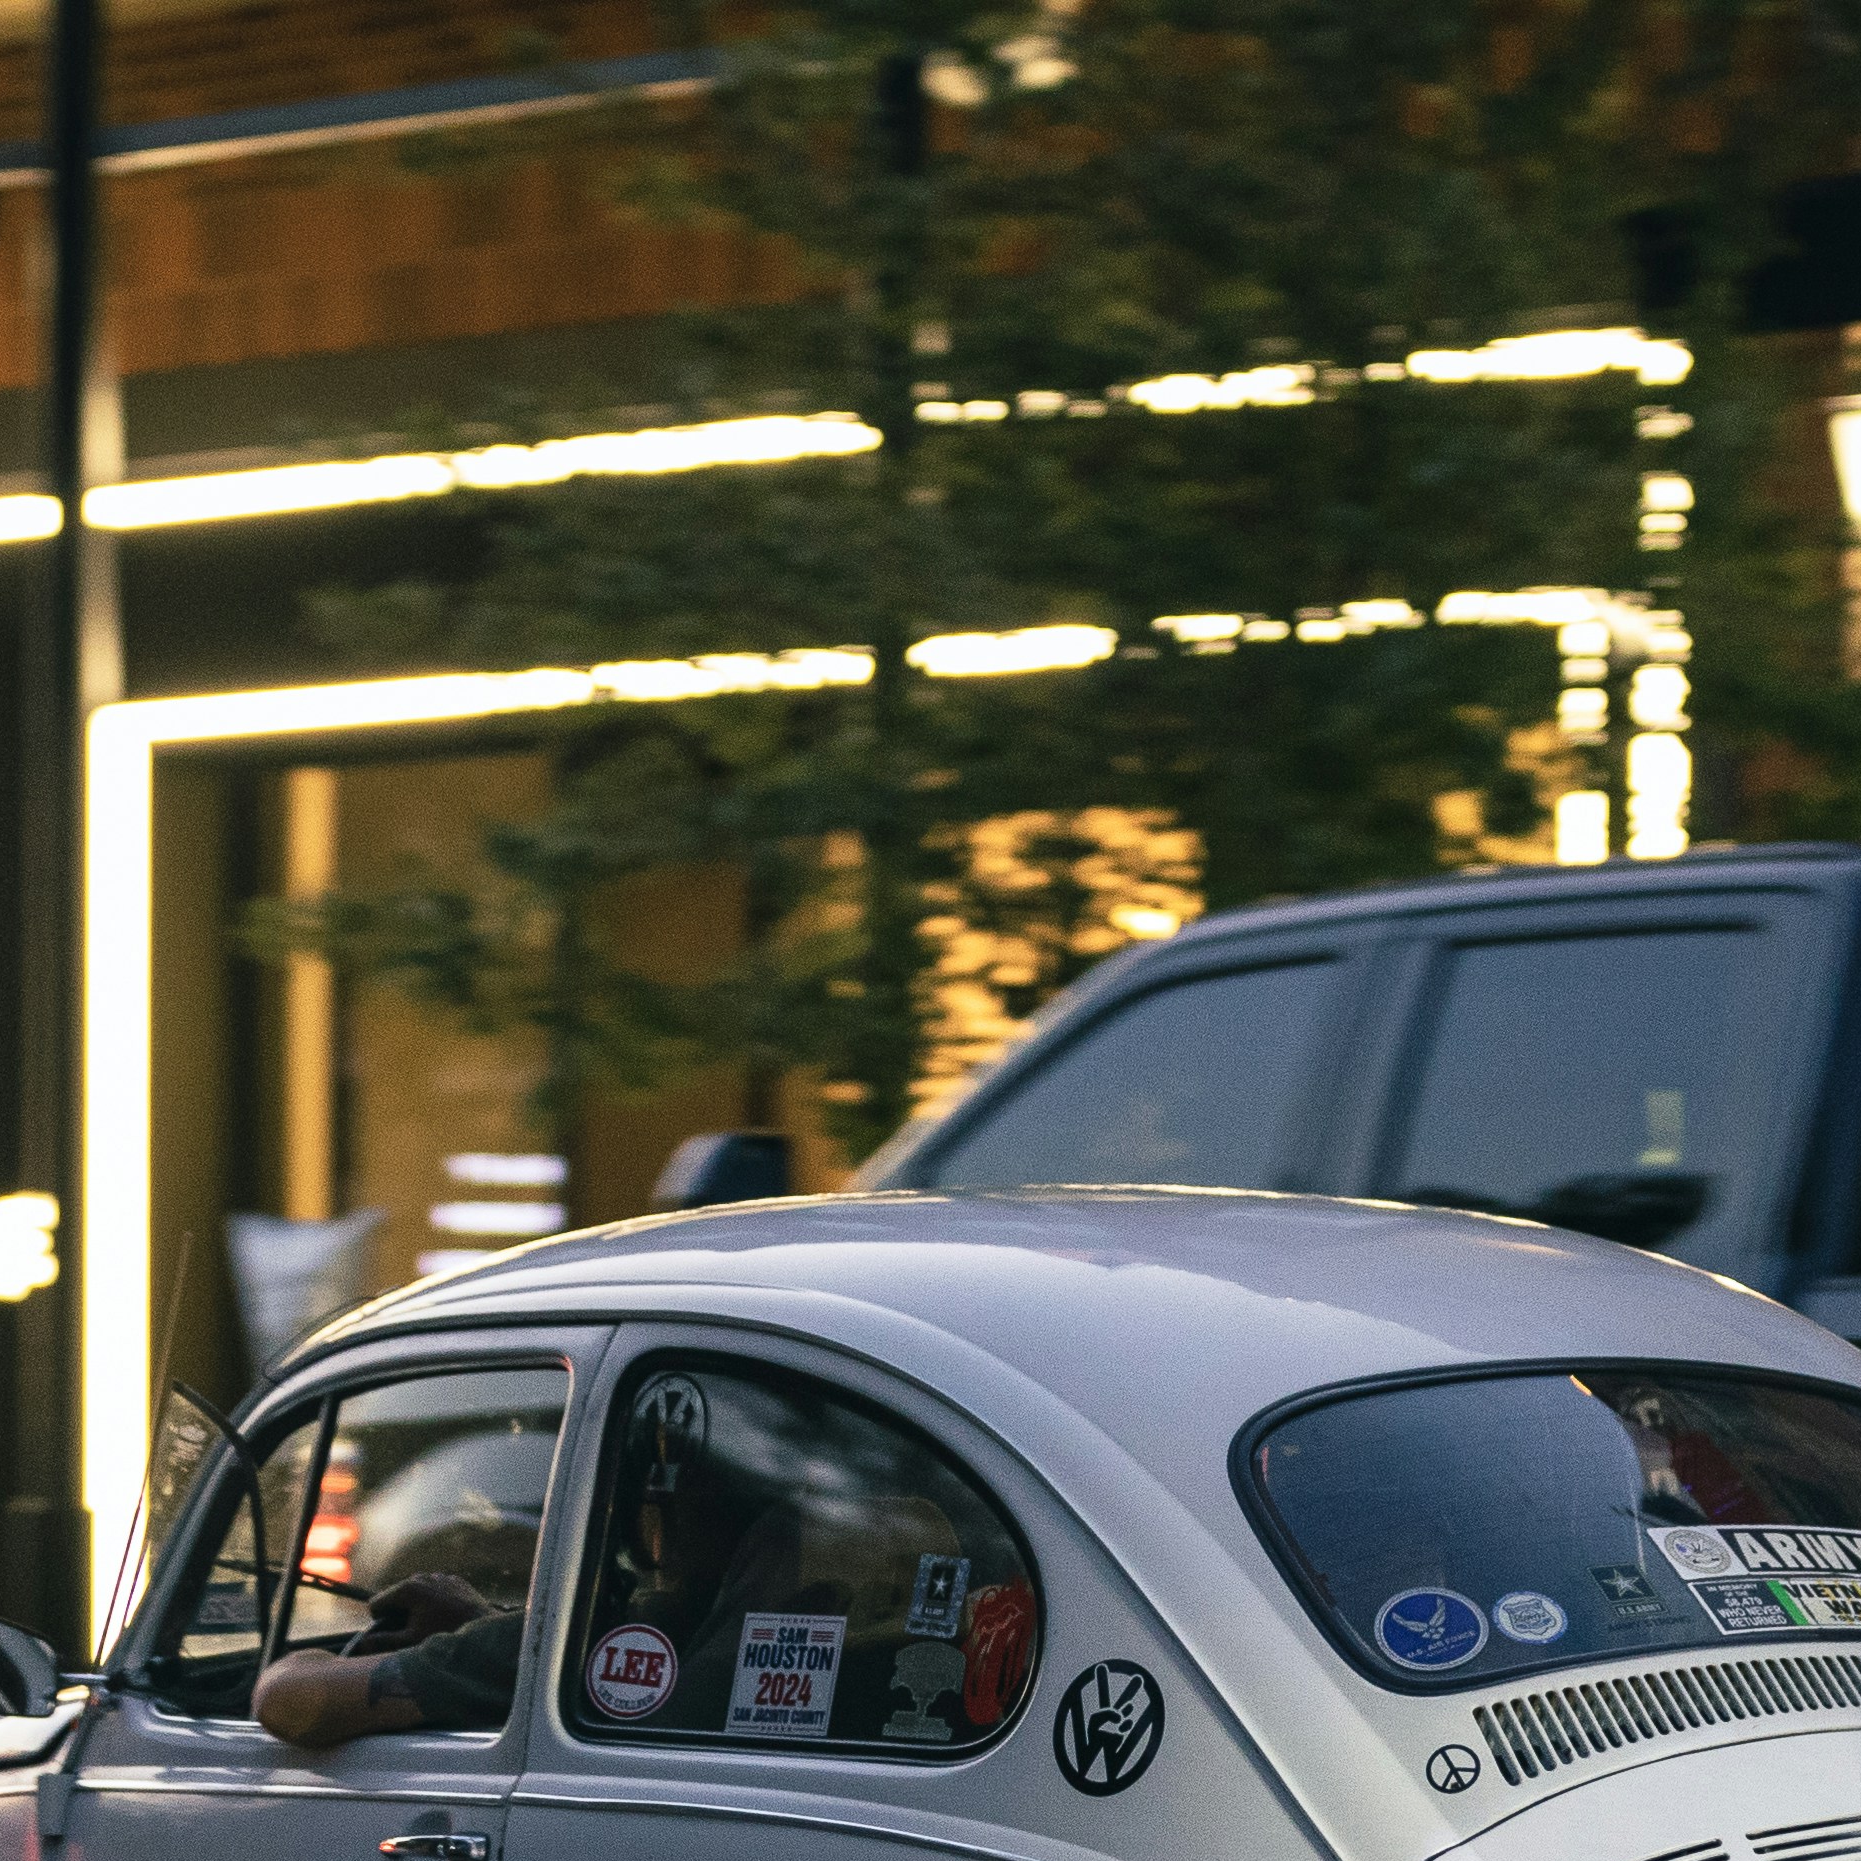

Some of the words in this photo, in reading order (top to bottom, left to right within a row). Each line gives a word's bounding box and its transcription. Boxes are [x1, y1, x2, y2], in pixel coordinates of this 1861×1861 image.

[1717, 1607, 1746, 1619] WHO
[1746, 1605, 1785, 1617] NEVER
[1727, 1615, 1788, 1628] RETURNED
[777, 1627, 809, 1644] SAM
[600, 1646, 667, 1689] LEE
[743, 1643, 835, 1671] HOUSTON
[754, 1672, 813, 1707] 2024
